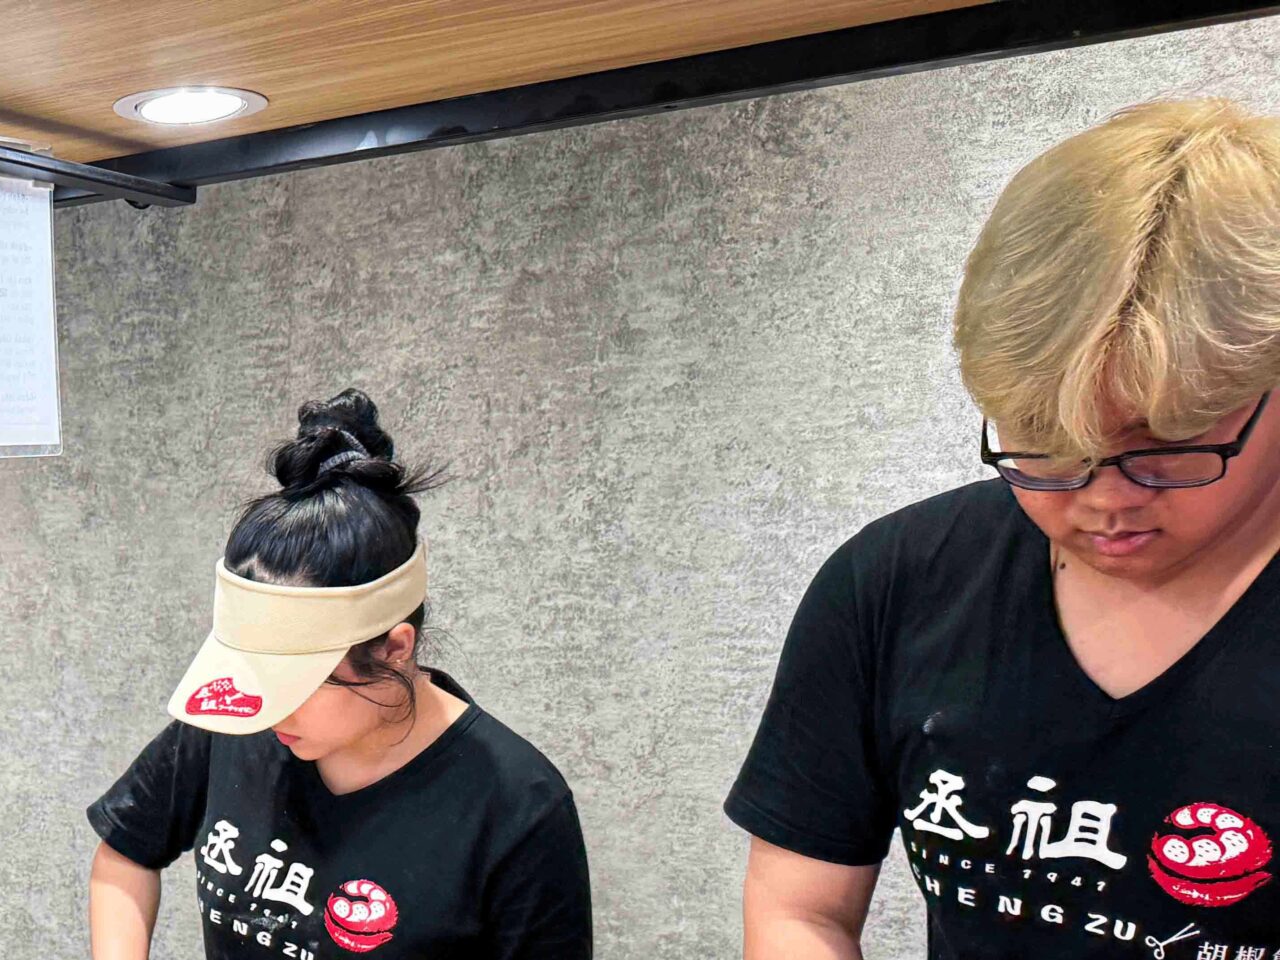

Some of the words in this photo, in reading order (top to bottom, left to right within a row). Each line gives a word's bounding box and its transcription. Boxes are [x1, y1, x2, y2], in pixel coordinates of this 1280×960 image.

[200, 819, 315, 916] 丞祖
[903, 768, 1128, 870] 丞祖
[910, 841, 996, 874] SINCE
